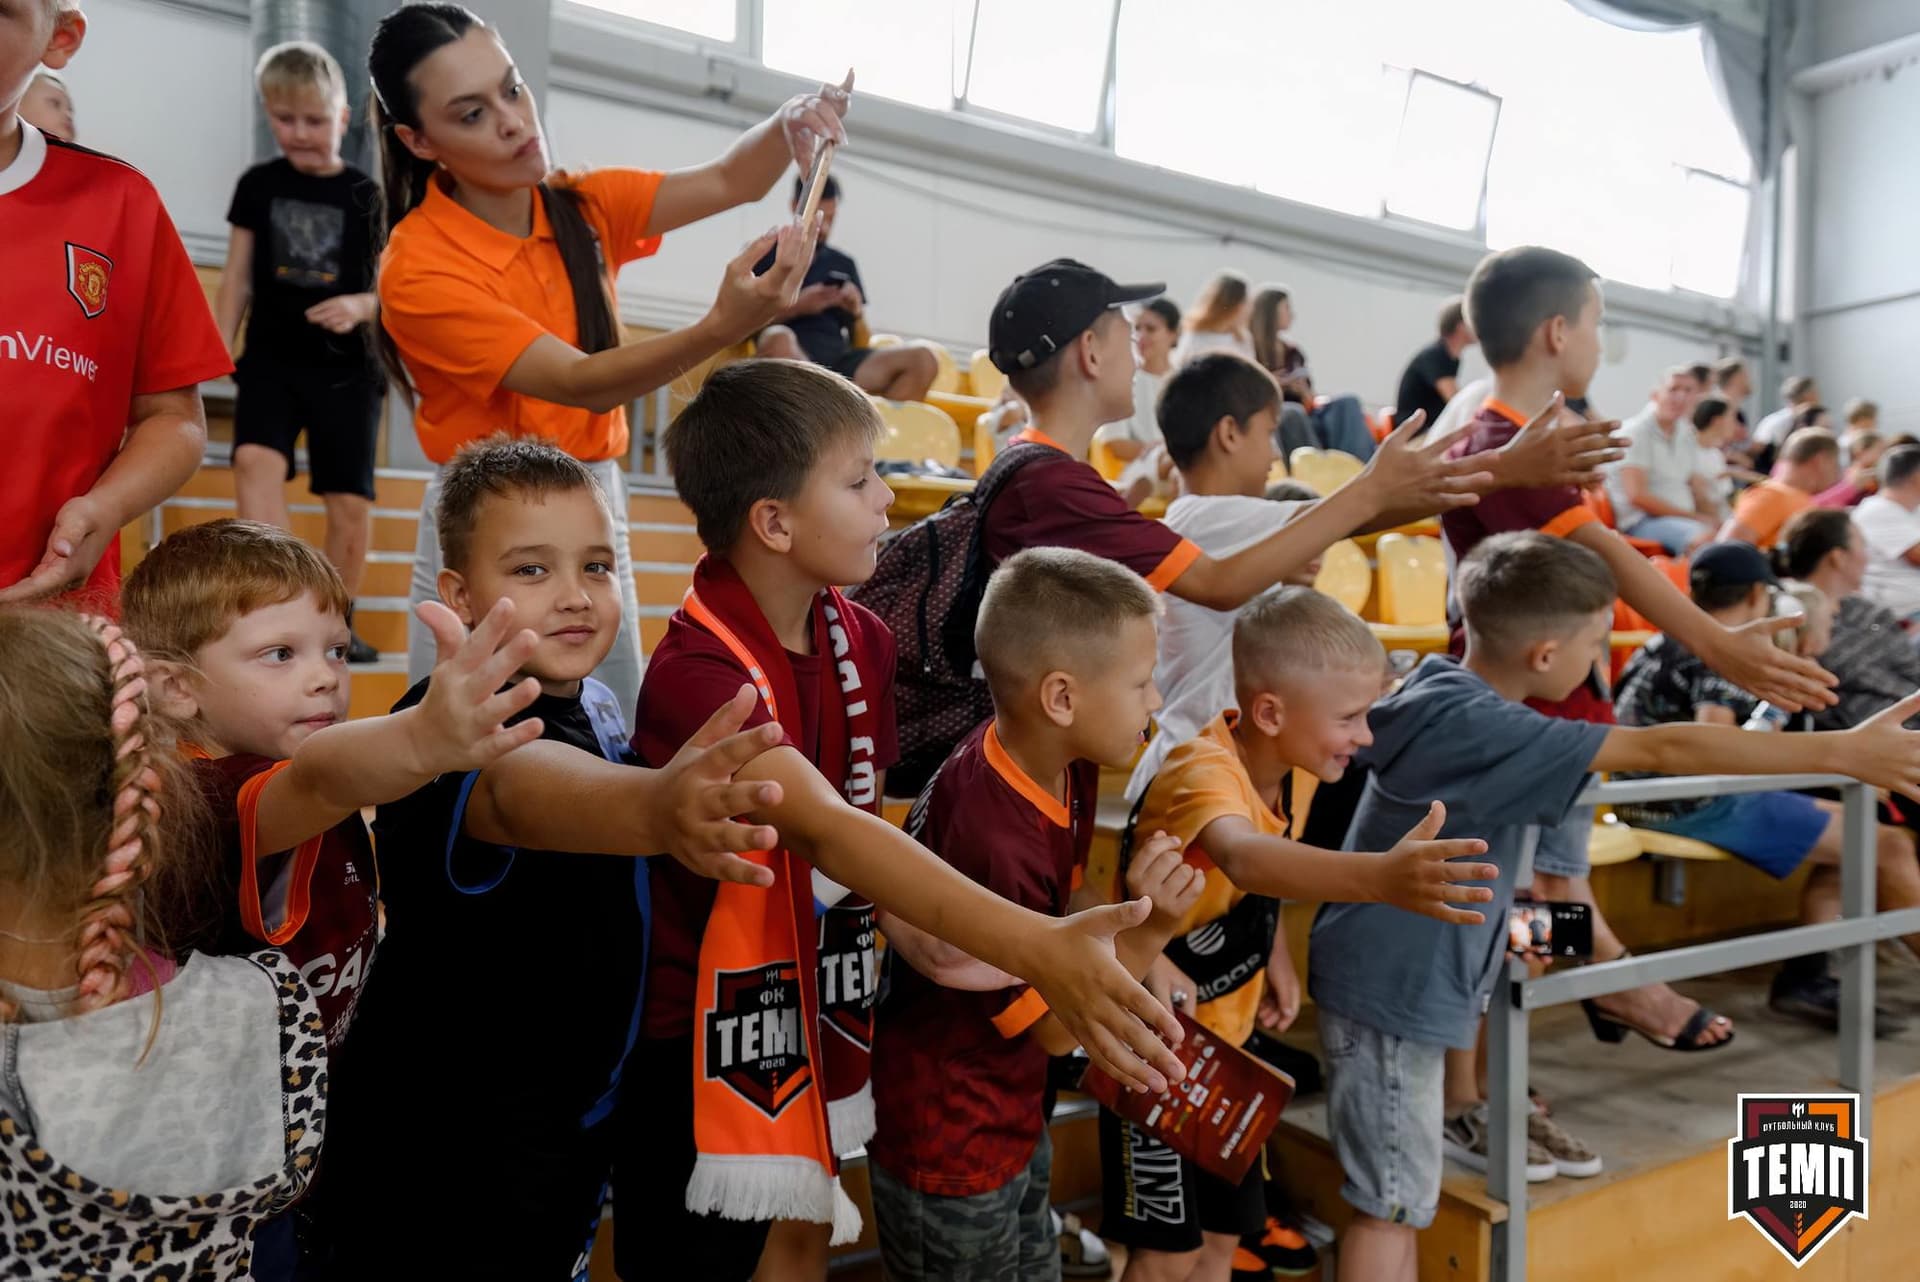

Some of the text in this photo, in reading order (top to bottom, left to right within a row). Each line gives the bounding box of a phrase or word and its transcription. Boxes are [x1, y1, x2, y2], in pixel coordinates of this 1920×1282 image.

[760, 986, 785, 1005] ФК
[716, 1007, 809, 1068] ТЕМ
[760, 1057, 786, 1070] 2020
